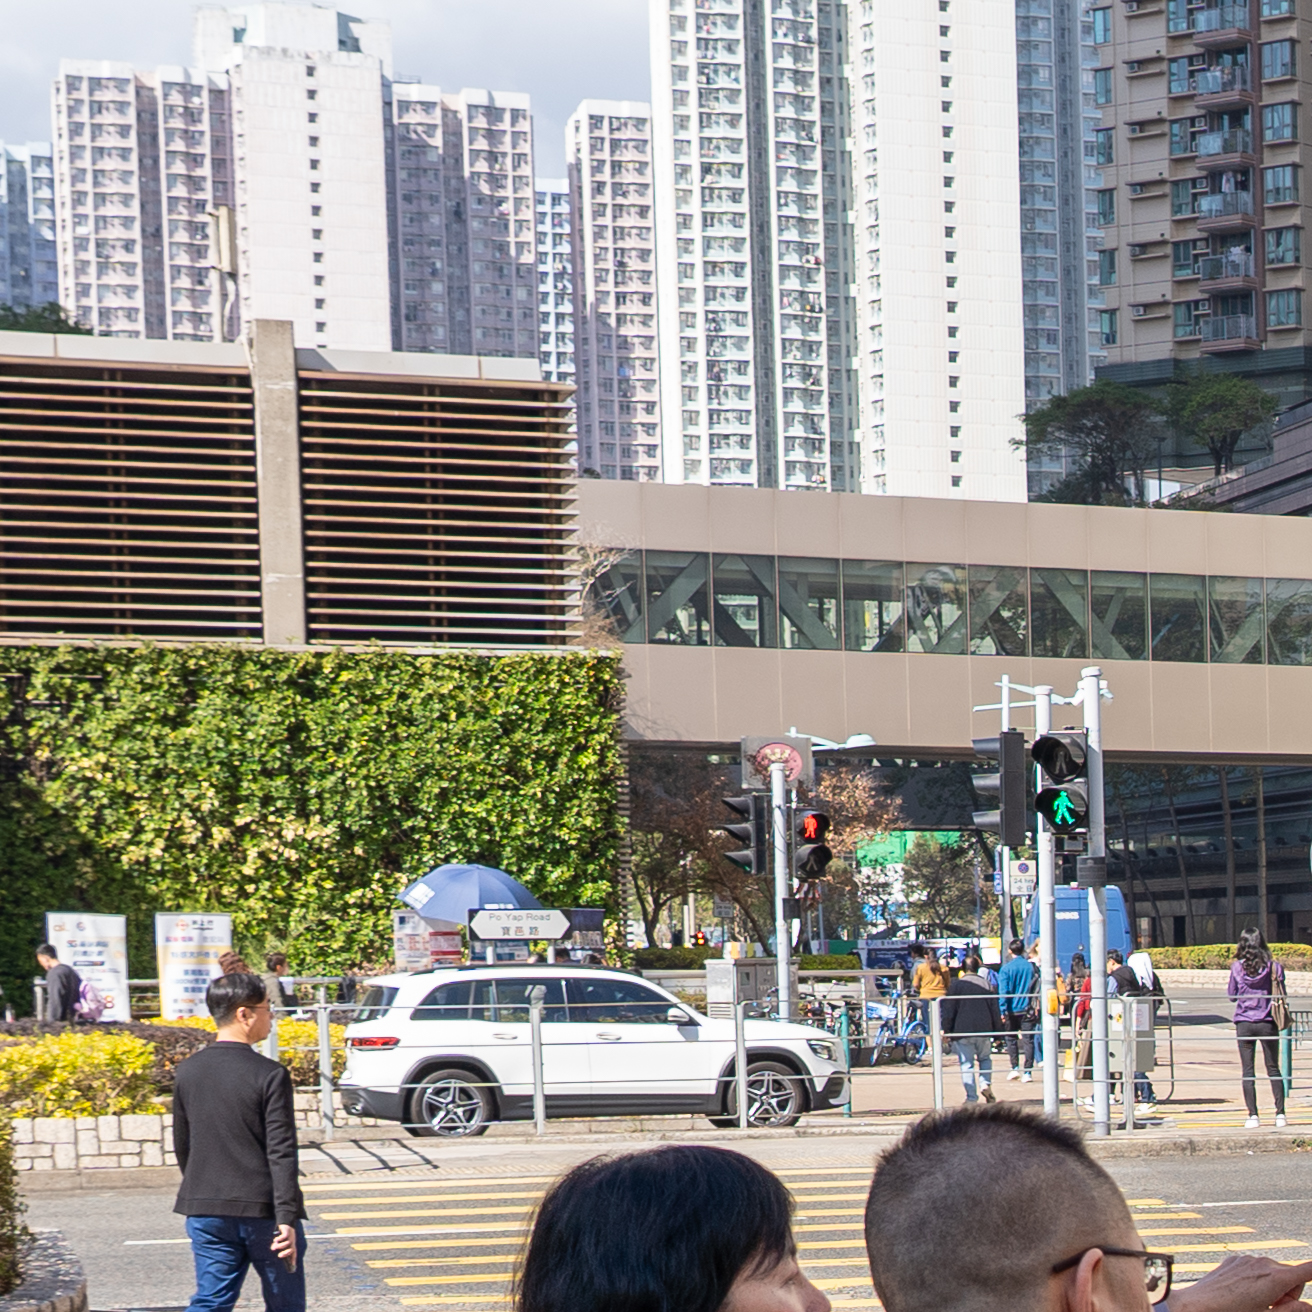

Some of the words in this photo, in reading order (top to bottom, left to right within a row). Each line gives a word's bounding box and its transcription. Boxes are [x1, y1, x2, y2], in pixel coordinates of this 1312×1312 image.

[489, 913, 502, 921] Po
[505, 913, 524, 922] Yap
[526, 913, 551, 921] Road
